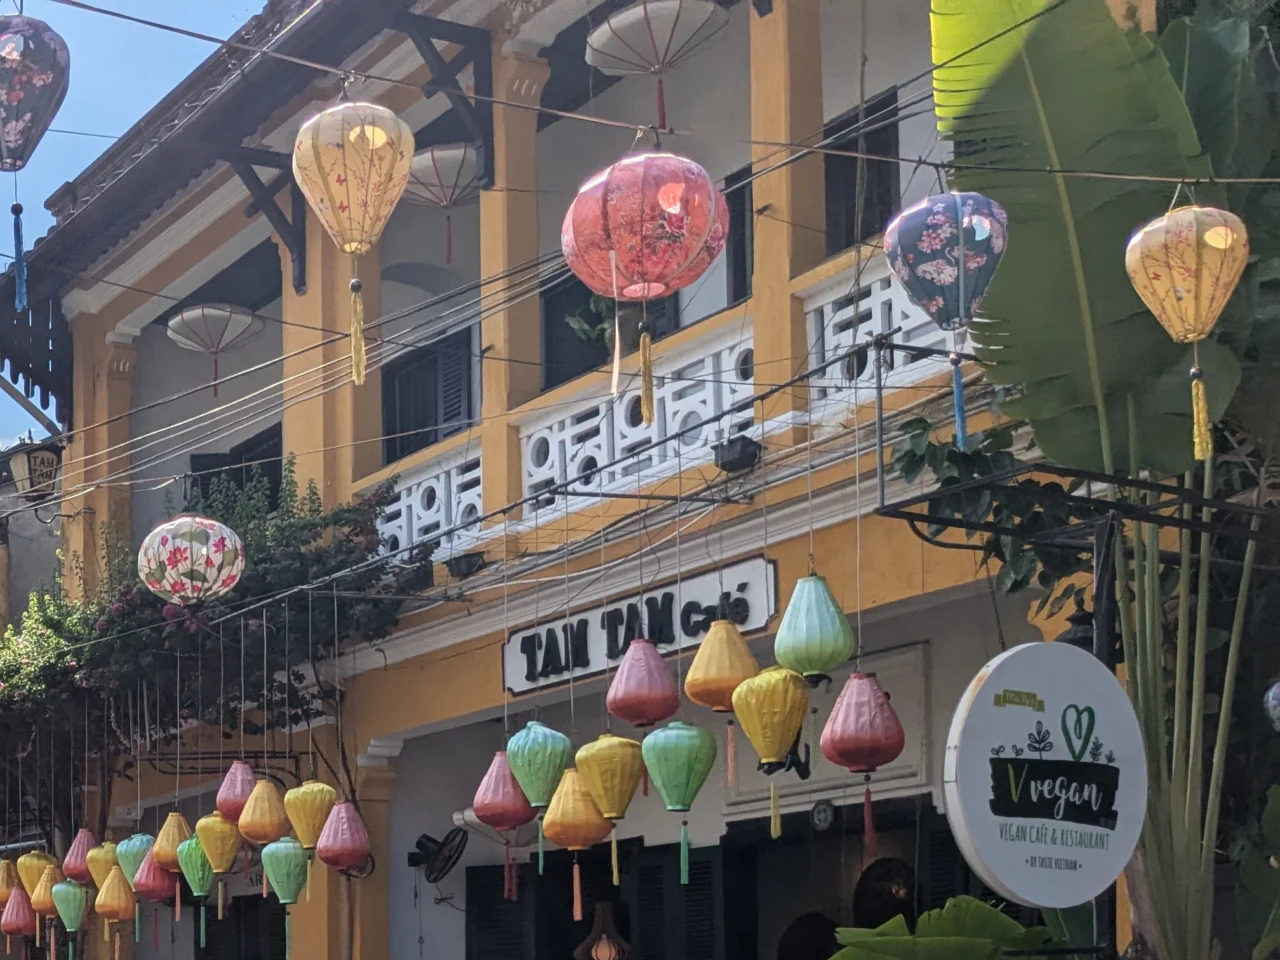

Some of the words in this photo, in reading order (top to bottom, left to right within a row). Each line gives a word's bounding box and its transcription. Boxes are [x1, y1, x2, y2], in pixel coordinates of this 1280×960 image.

[32, 456, 54, 468] TAM
[520, 618, 590, 682] TAM
[601, 592, 676, 660] TAM
[999, 822, 1027, 842] VEGAN
[1029, 823, 1049, 845] CAFÉ
[1050, 828, 1058, 845] &
[1060, 829, 1110, 851] RESTAURANT
[1030, 856, 1037, 867] BY
[1038, 856, 1053, 870] TASTE
[1054, 857, 1078, 871] VIETNAM
